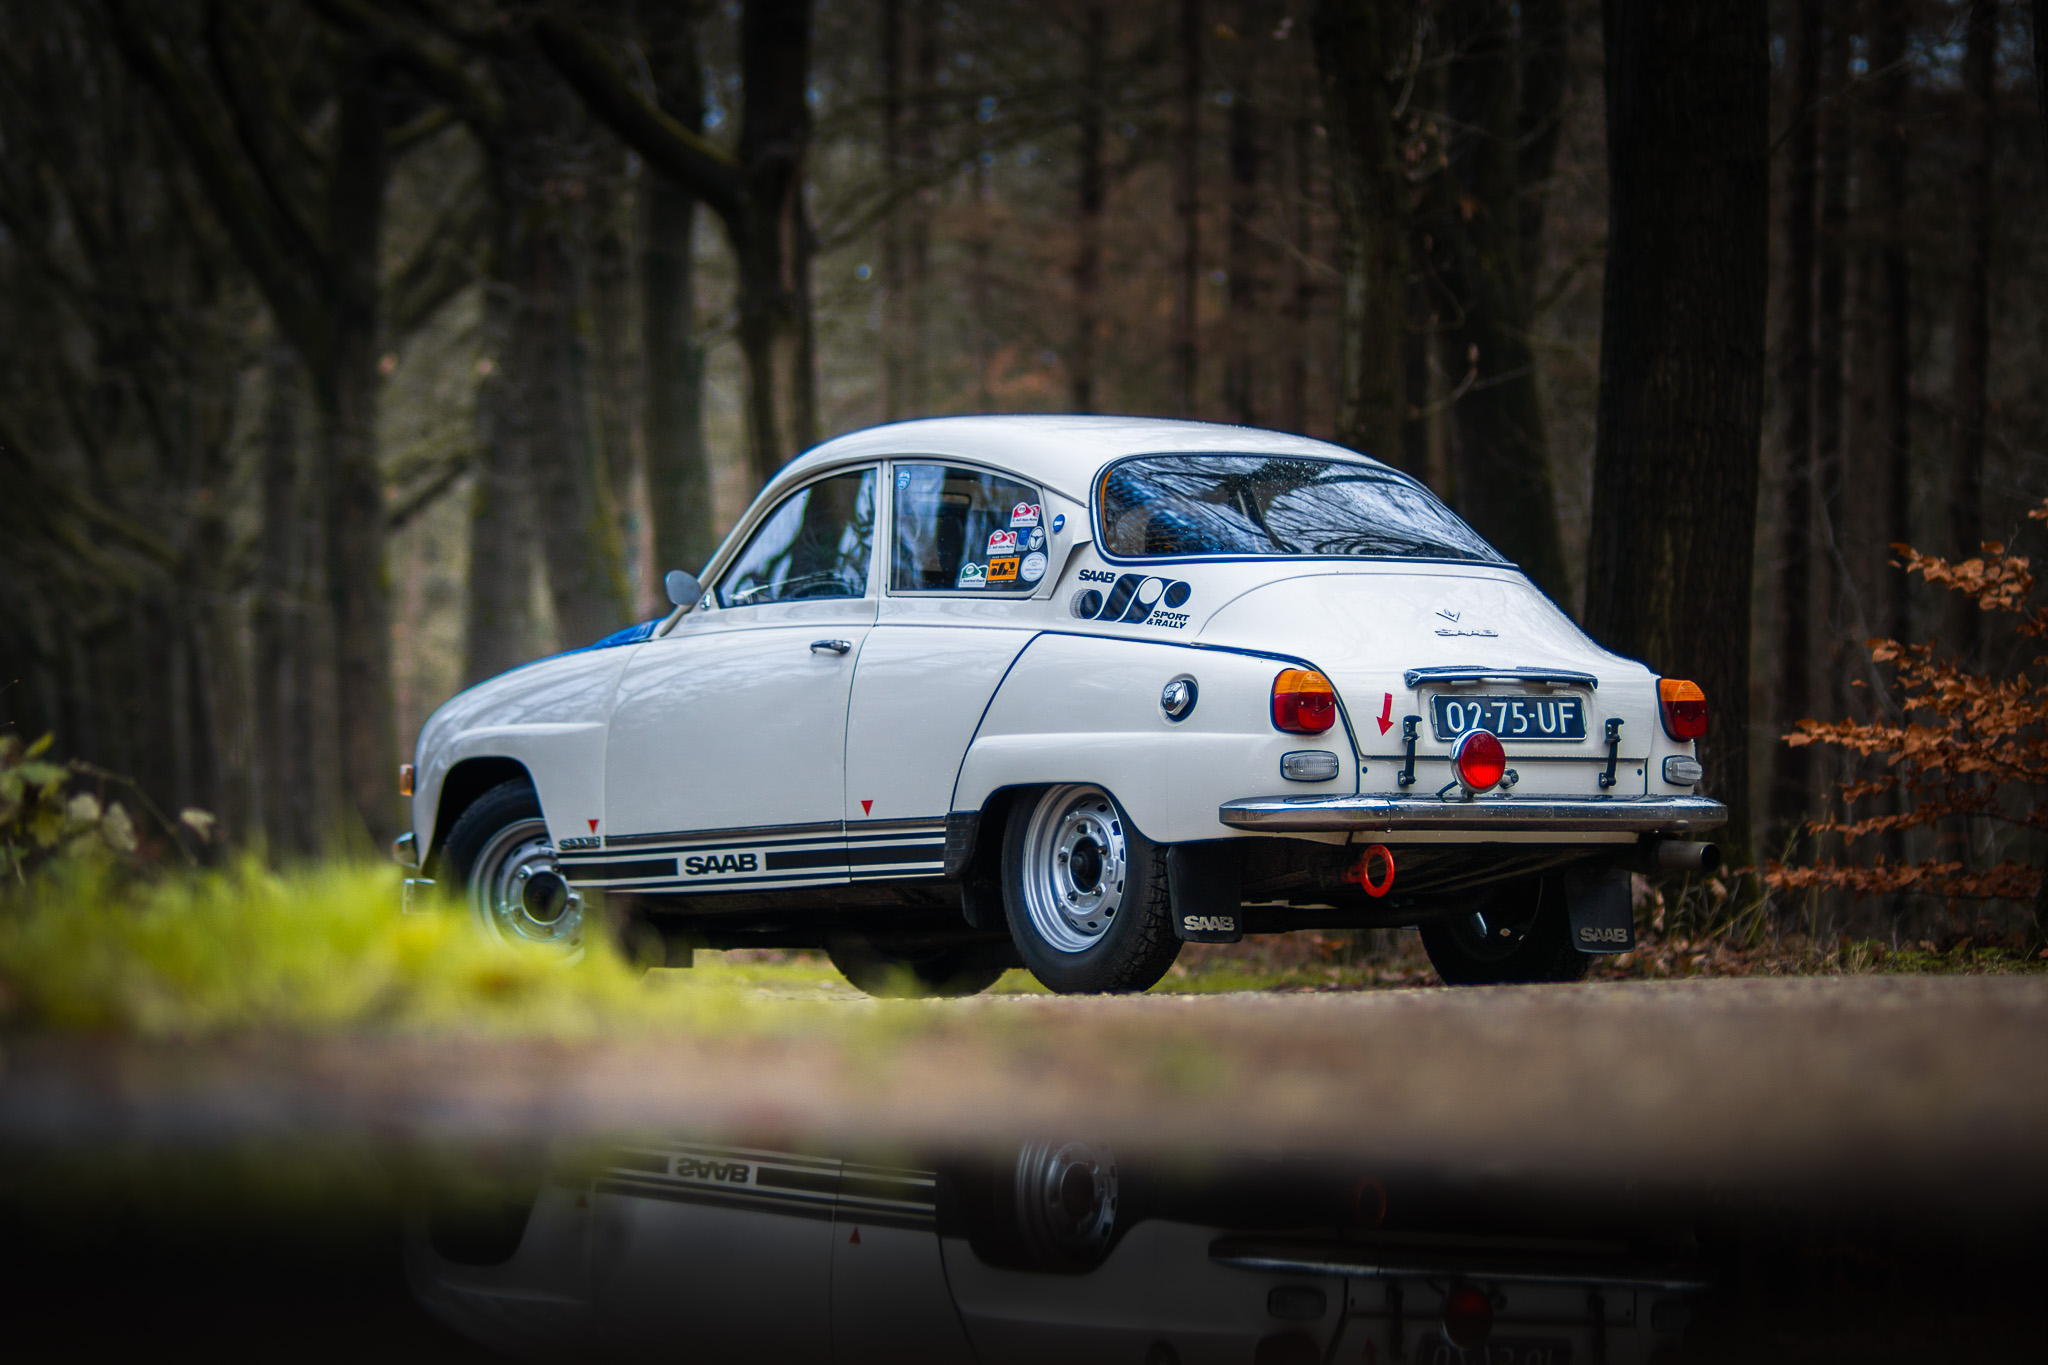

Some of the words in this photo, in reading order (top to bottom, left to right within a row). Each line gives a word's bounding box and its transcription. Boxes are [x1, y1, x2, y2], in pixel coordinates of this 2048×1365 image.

[1078, 569, 1116, 584] SAAB
[1152, 610, 1190, 622] SPORT
[1446, 702, 1575, 734] 02-75-UF
[684, 853, 758, 876] SAAB
[1184, 915, 1235, 931] SAAB
[1580, 927, 1628, 943] SAAB
